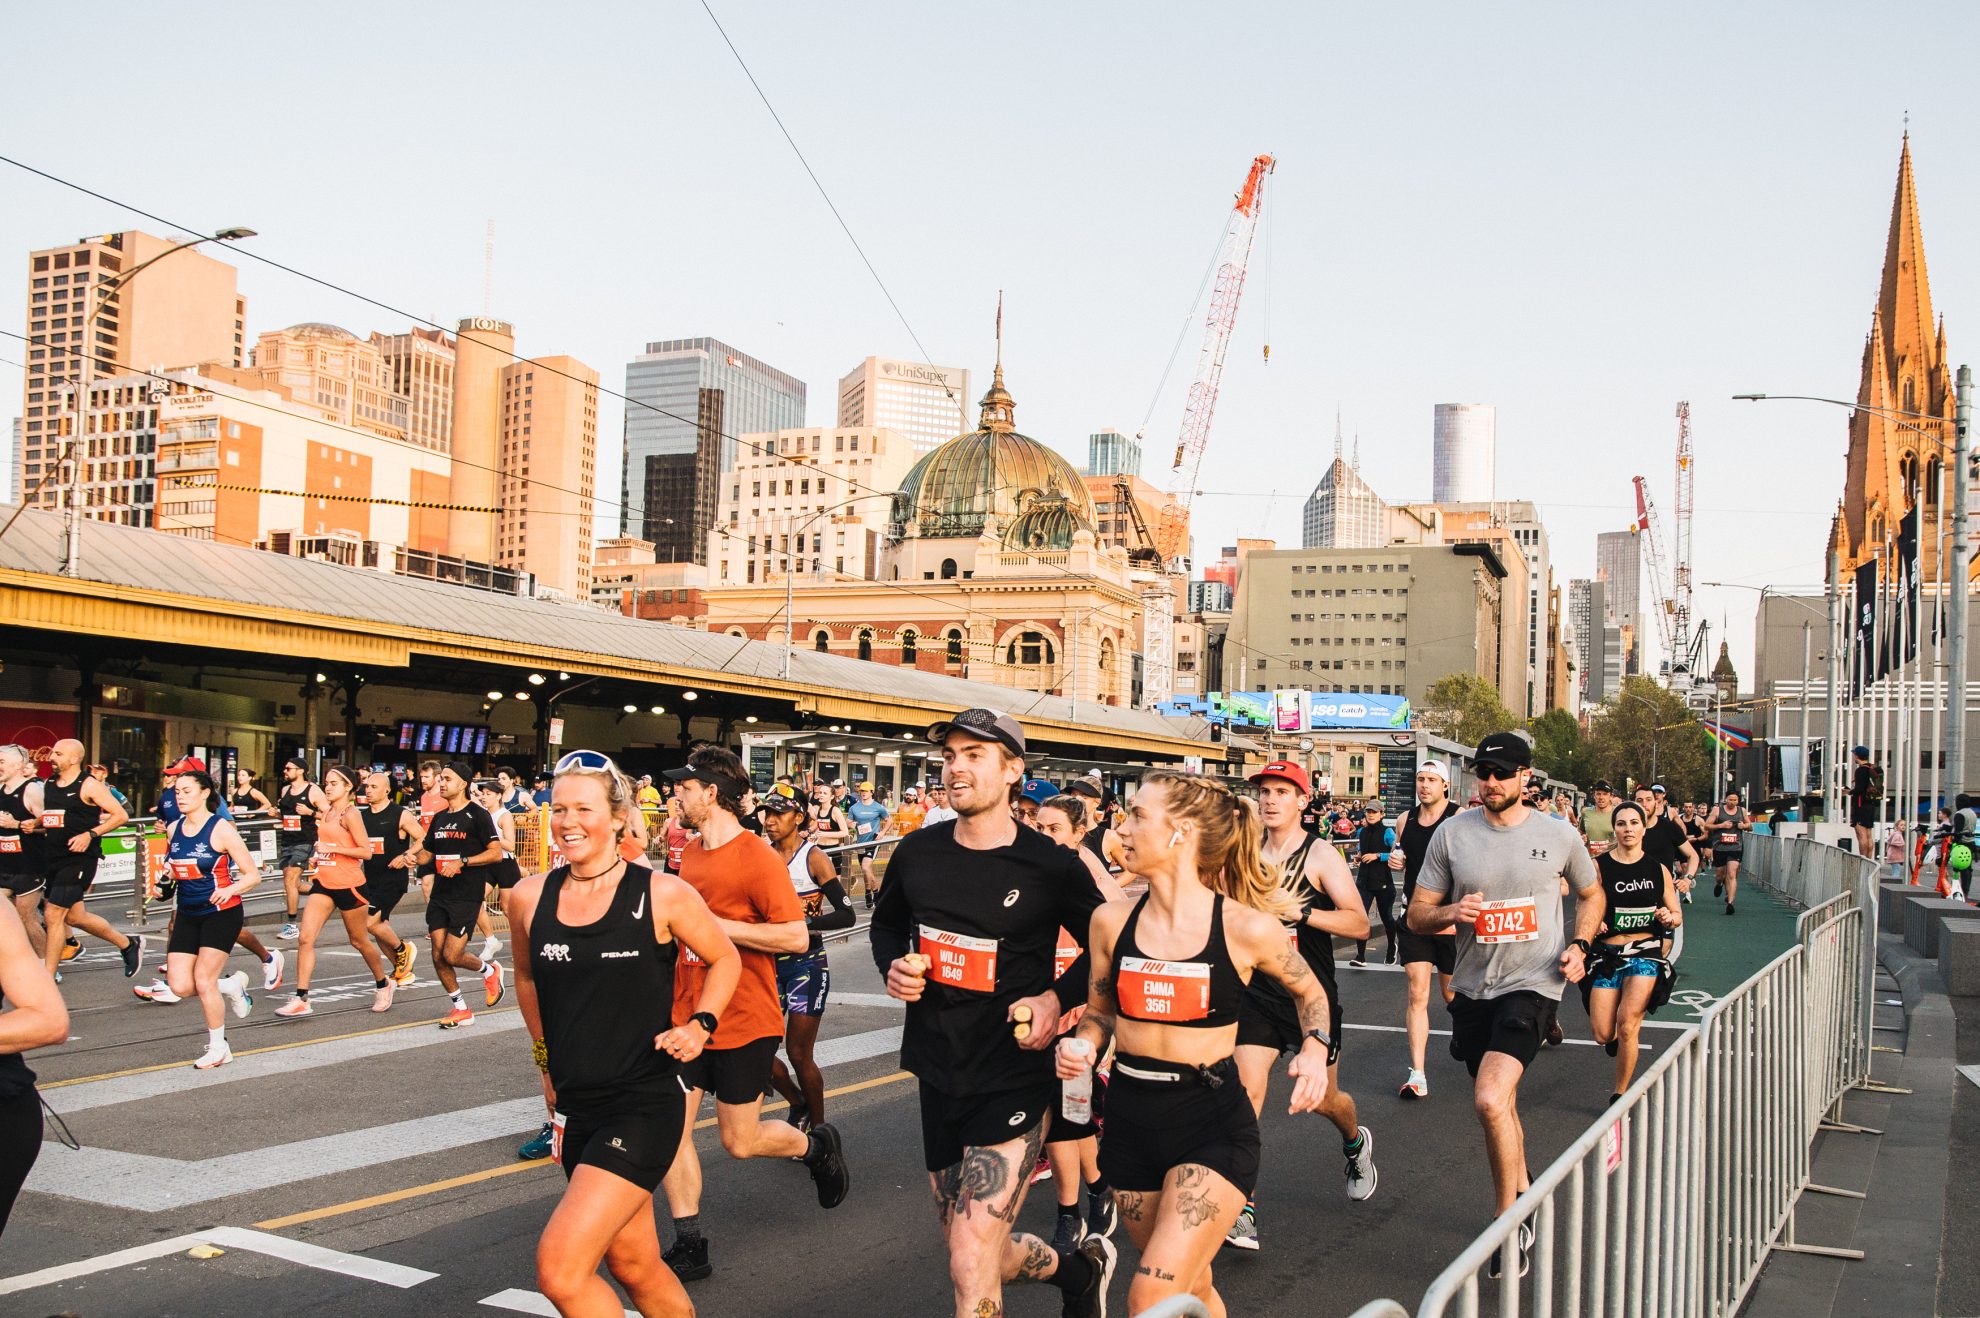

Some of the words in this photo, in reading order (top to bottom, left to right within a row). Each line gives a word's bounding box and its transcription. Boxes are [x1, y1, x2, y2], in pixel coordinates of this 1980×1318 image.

[897, 364, 948, 383] UniSuper
[1341, 705, 1364, 714] catch
[1615, 878, 1654, 893] Calvin
[1484, 911, 1525, 933] 3742
[1616, 914, 1651, 928] 43752
[601, 950, 639, 958] FEMMI
[940, 949, 966, 967] WILLO
[941, 965, 963, 982] 1649
[1143, 979, 1175, 998] EMMA
[1145, 997, 1171, 1014] 3561
